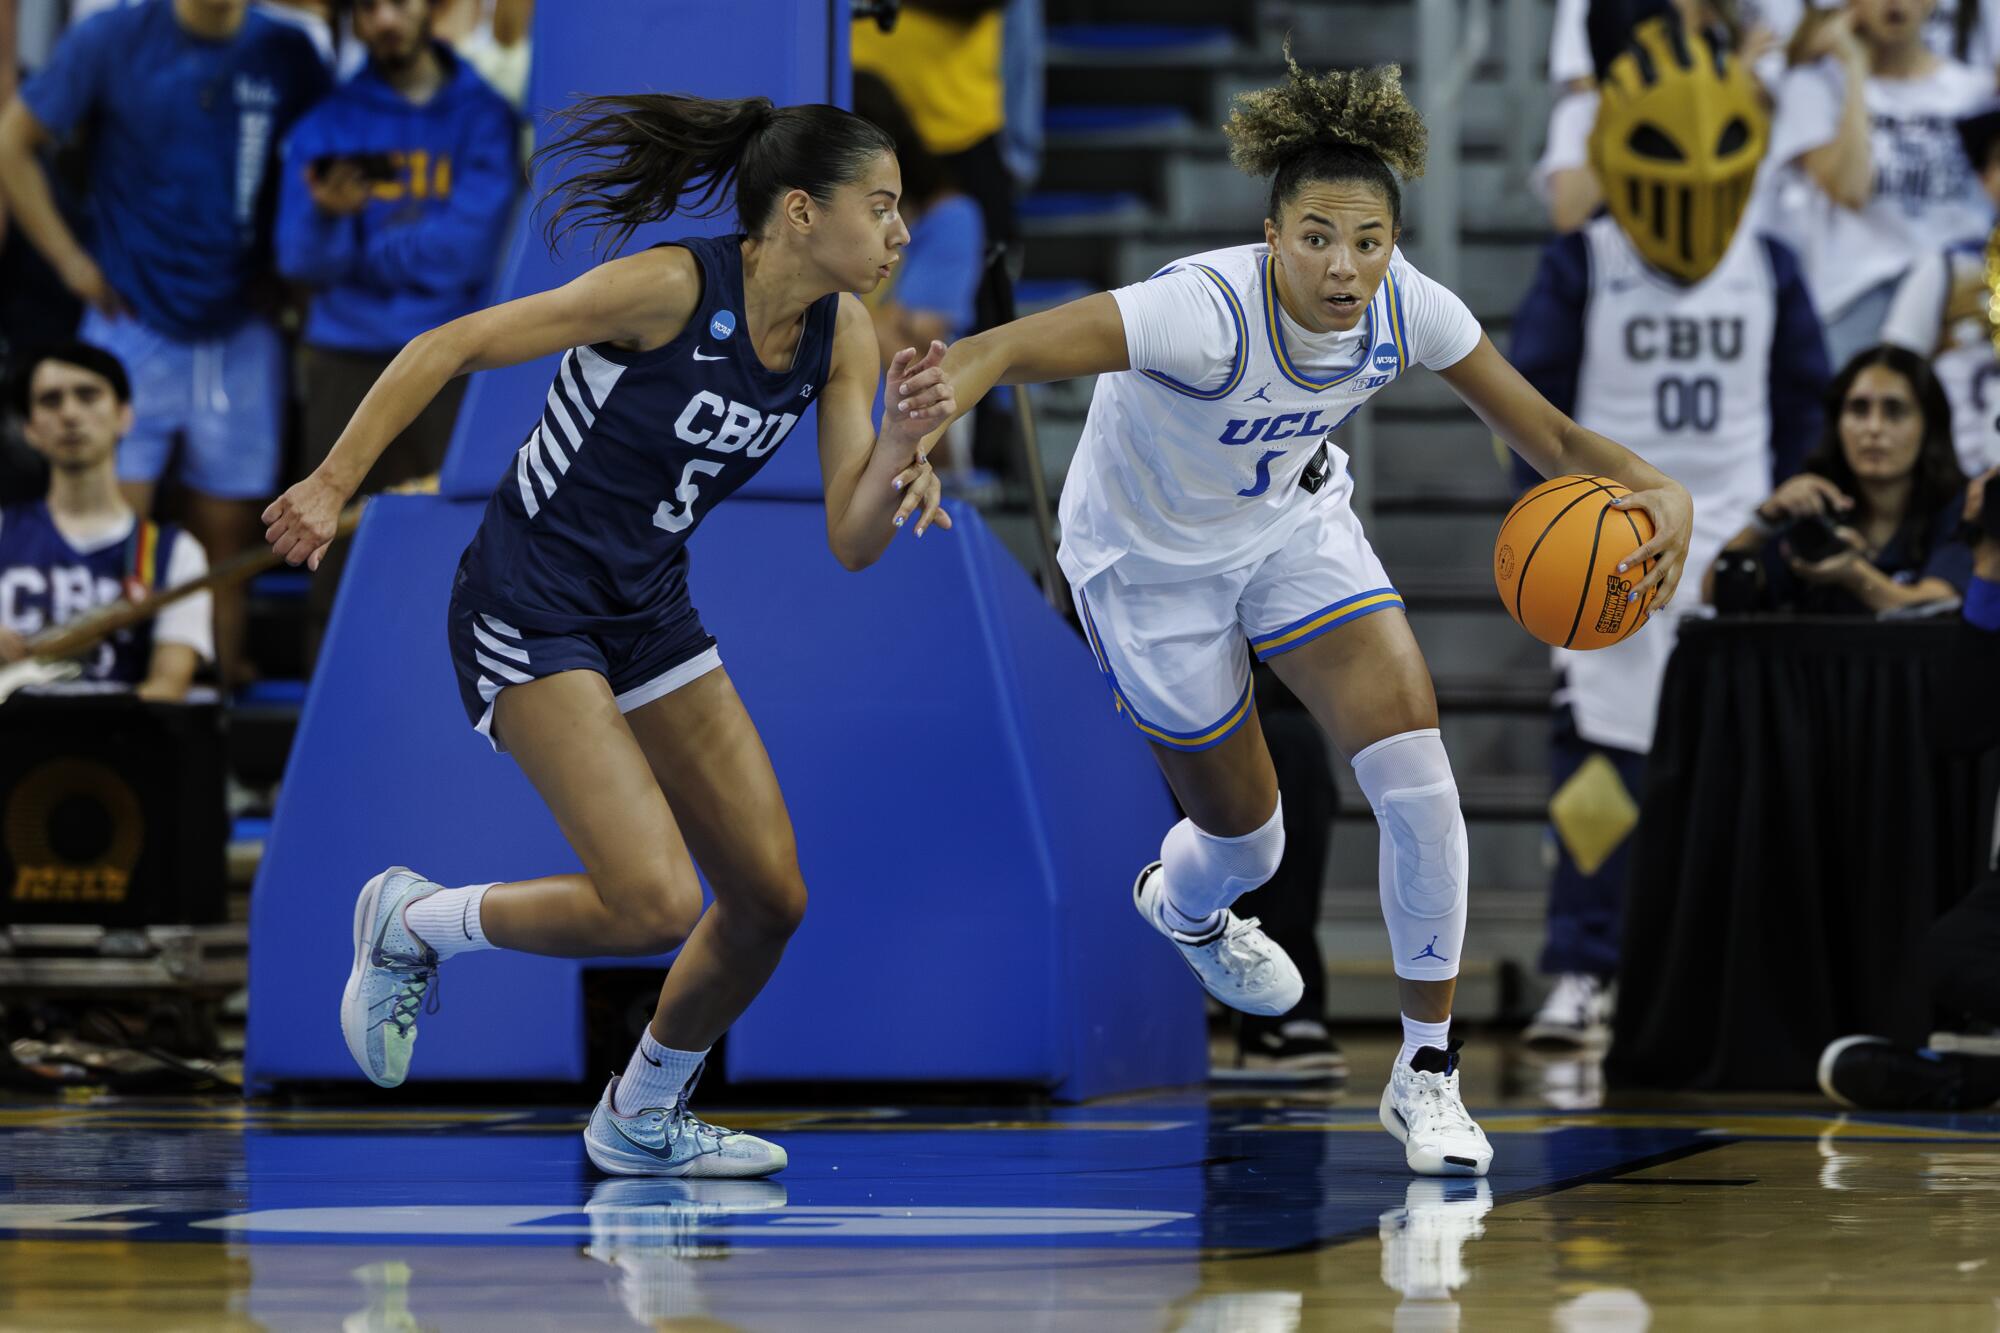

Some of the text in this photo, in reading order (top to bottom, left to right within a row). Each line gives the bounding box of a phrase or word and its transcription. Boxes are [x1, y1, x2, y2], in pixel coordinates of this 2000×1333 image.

[1375, 355, 1397, 364] NCAA
[1625, 316, 1743, 363] CBU
[674, 389, 799, 458] CBU
[1657, 374, 1721, 432] 00
[653, 459, 726, 533] 5
